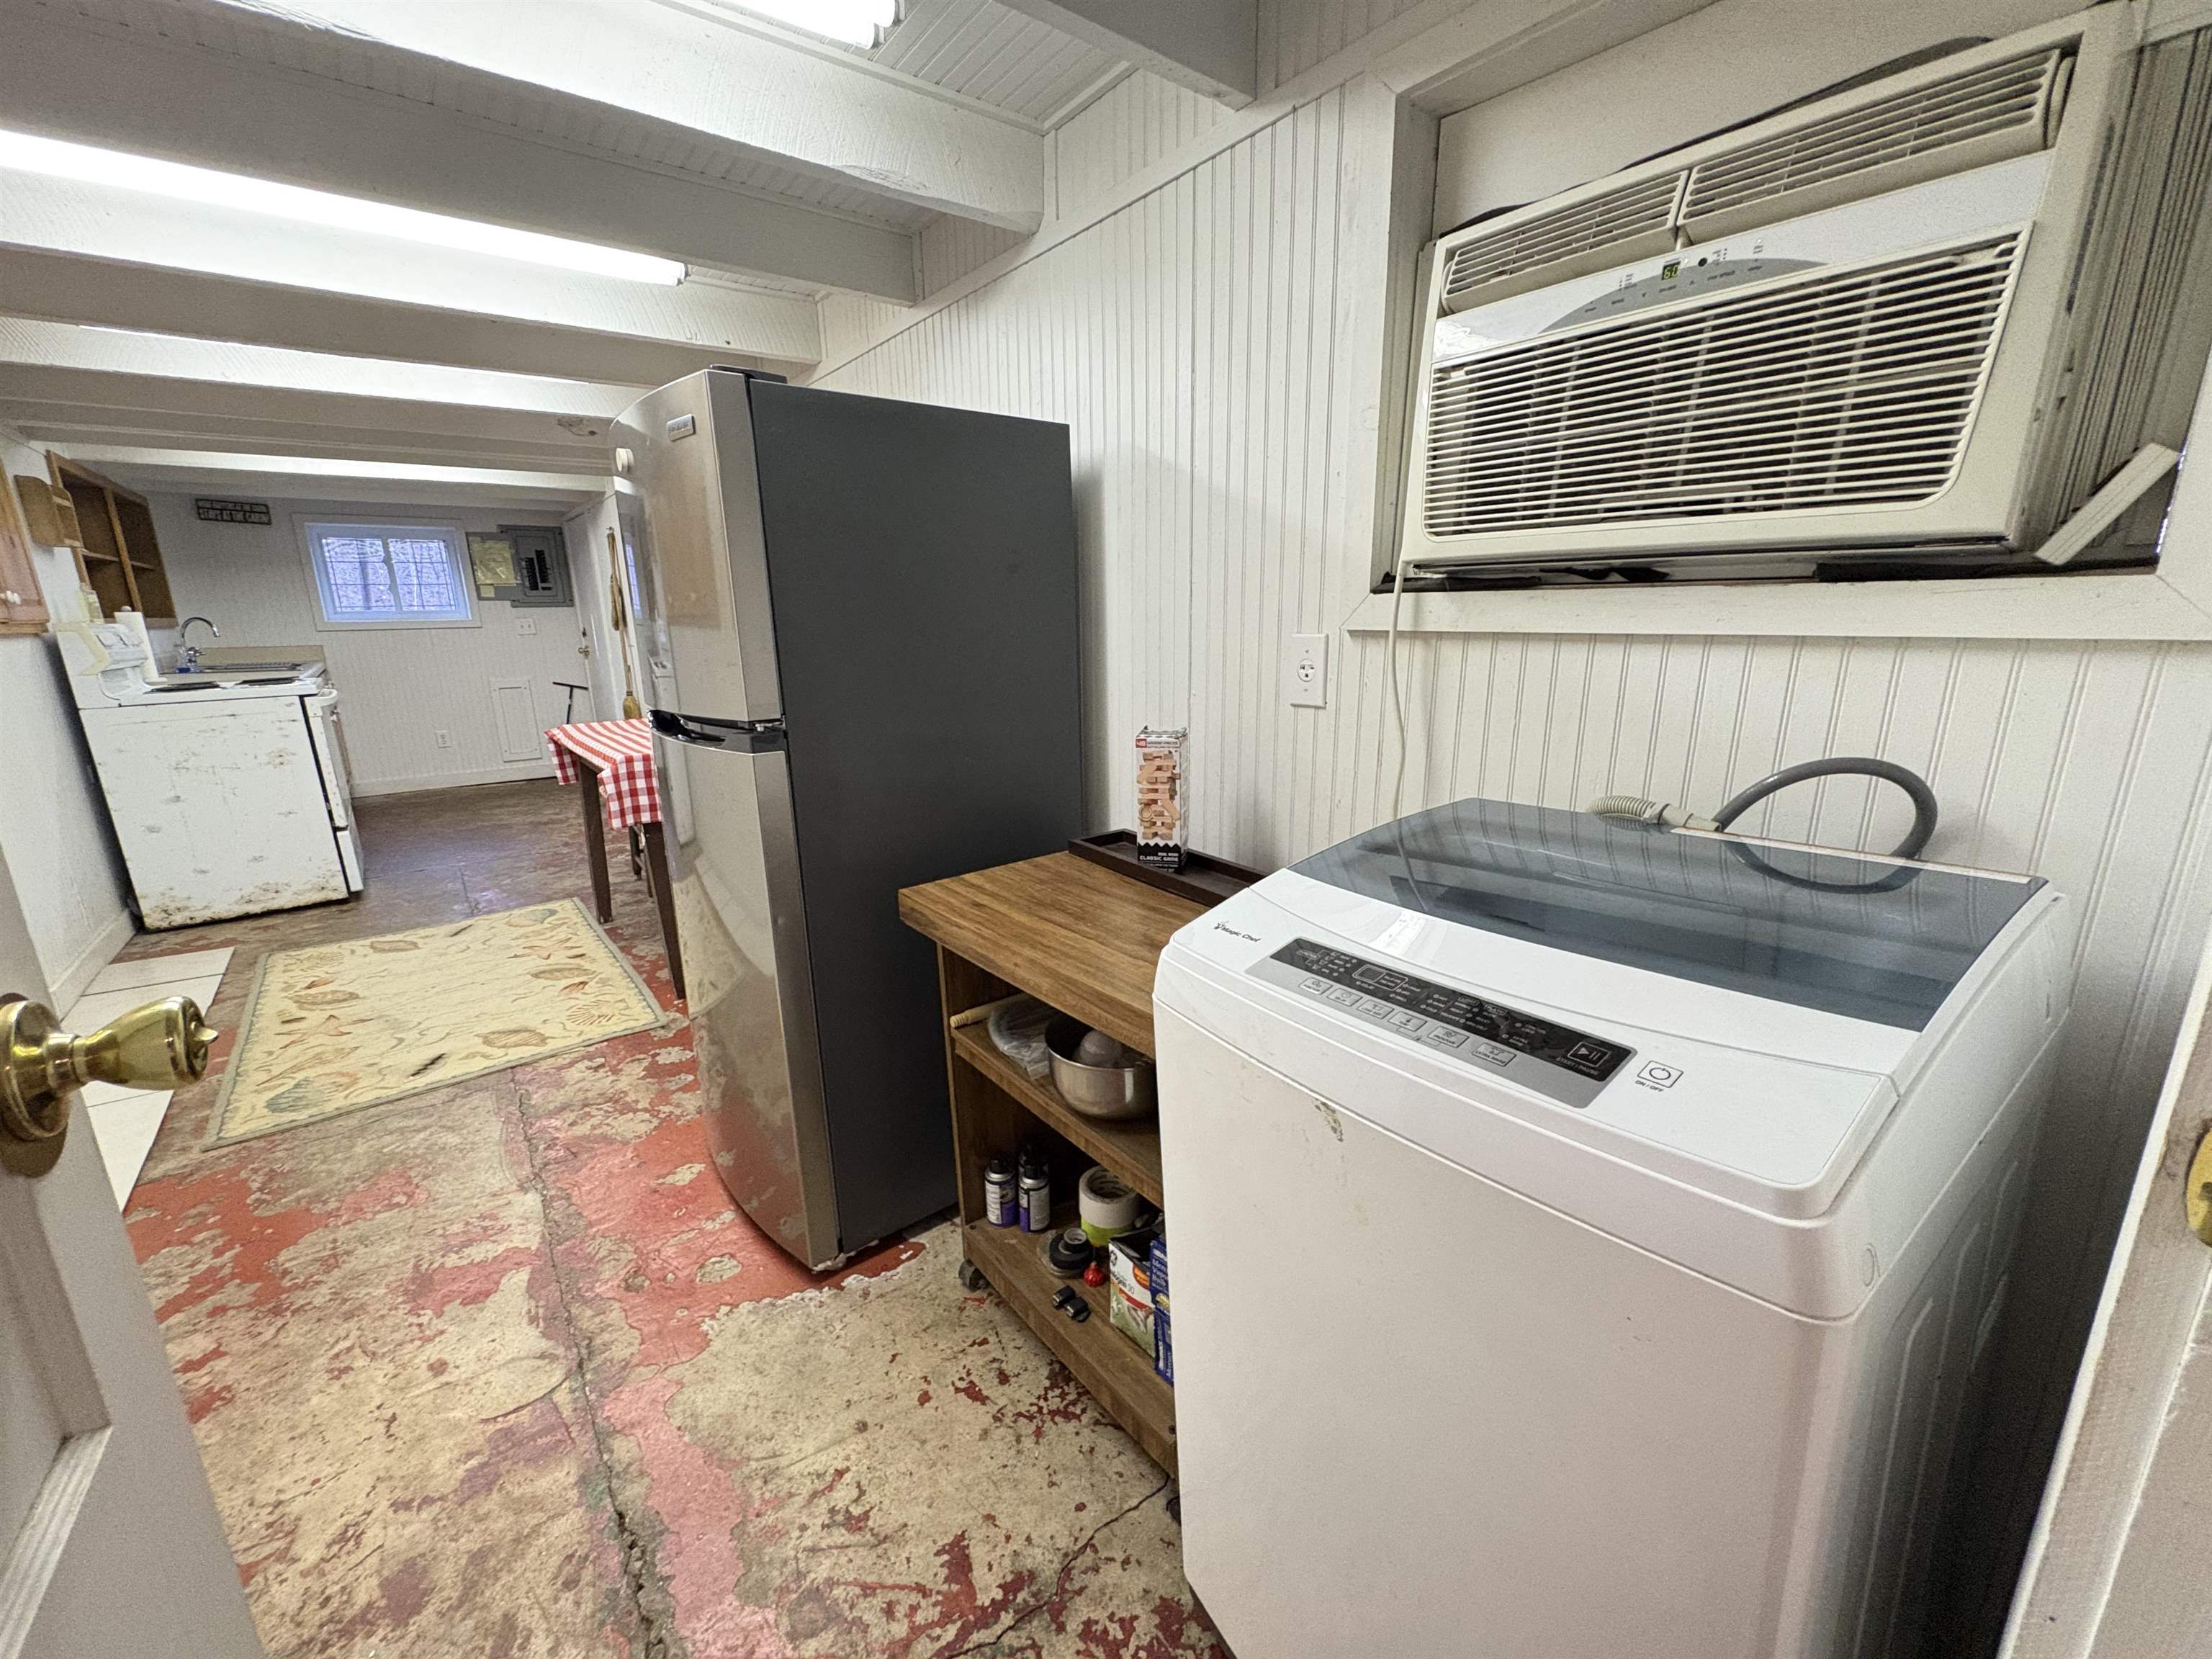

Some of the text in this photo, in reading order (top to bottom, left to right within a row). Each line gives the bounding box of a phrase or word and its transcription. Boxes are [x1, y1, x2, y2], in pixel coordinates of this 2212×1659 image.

[1220, 927, 1262, 943] Magic Chef
[1650, 1084, 1665, 1093] OFF
